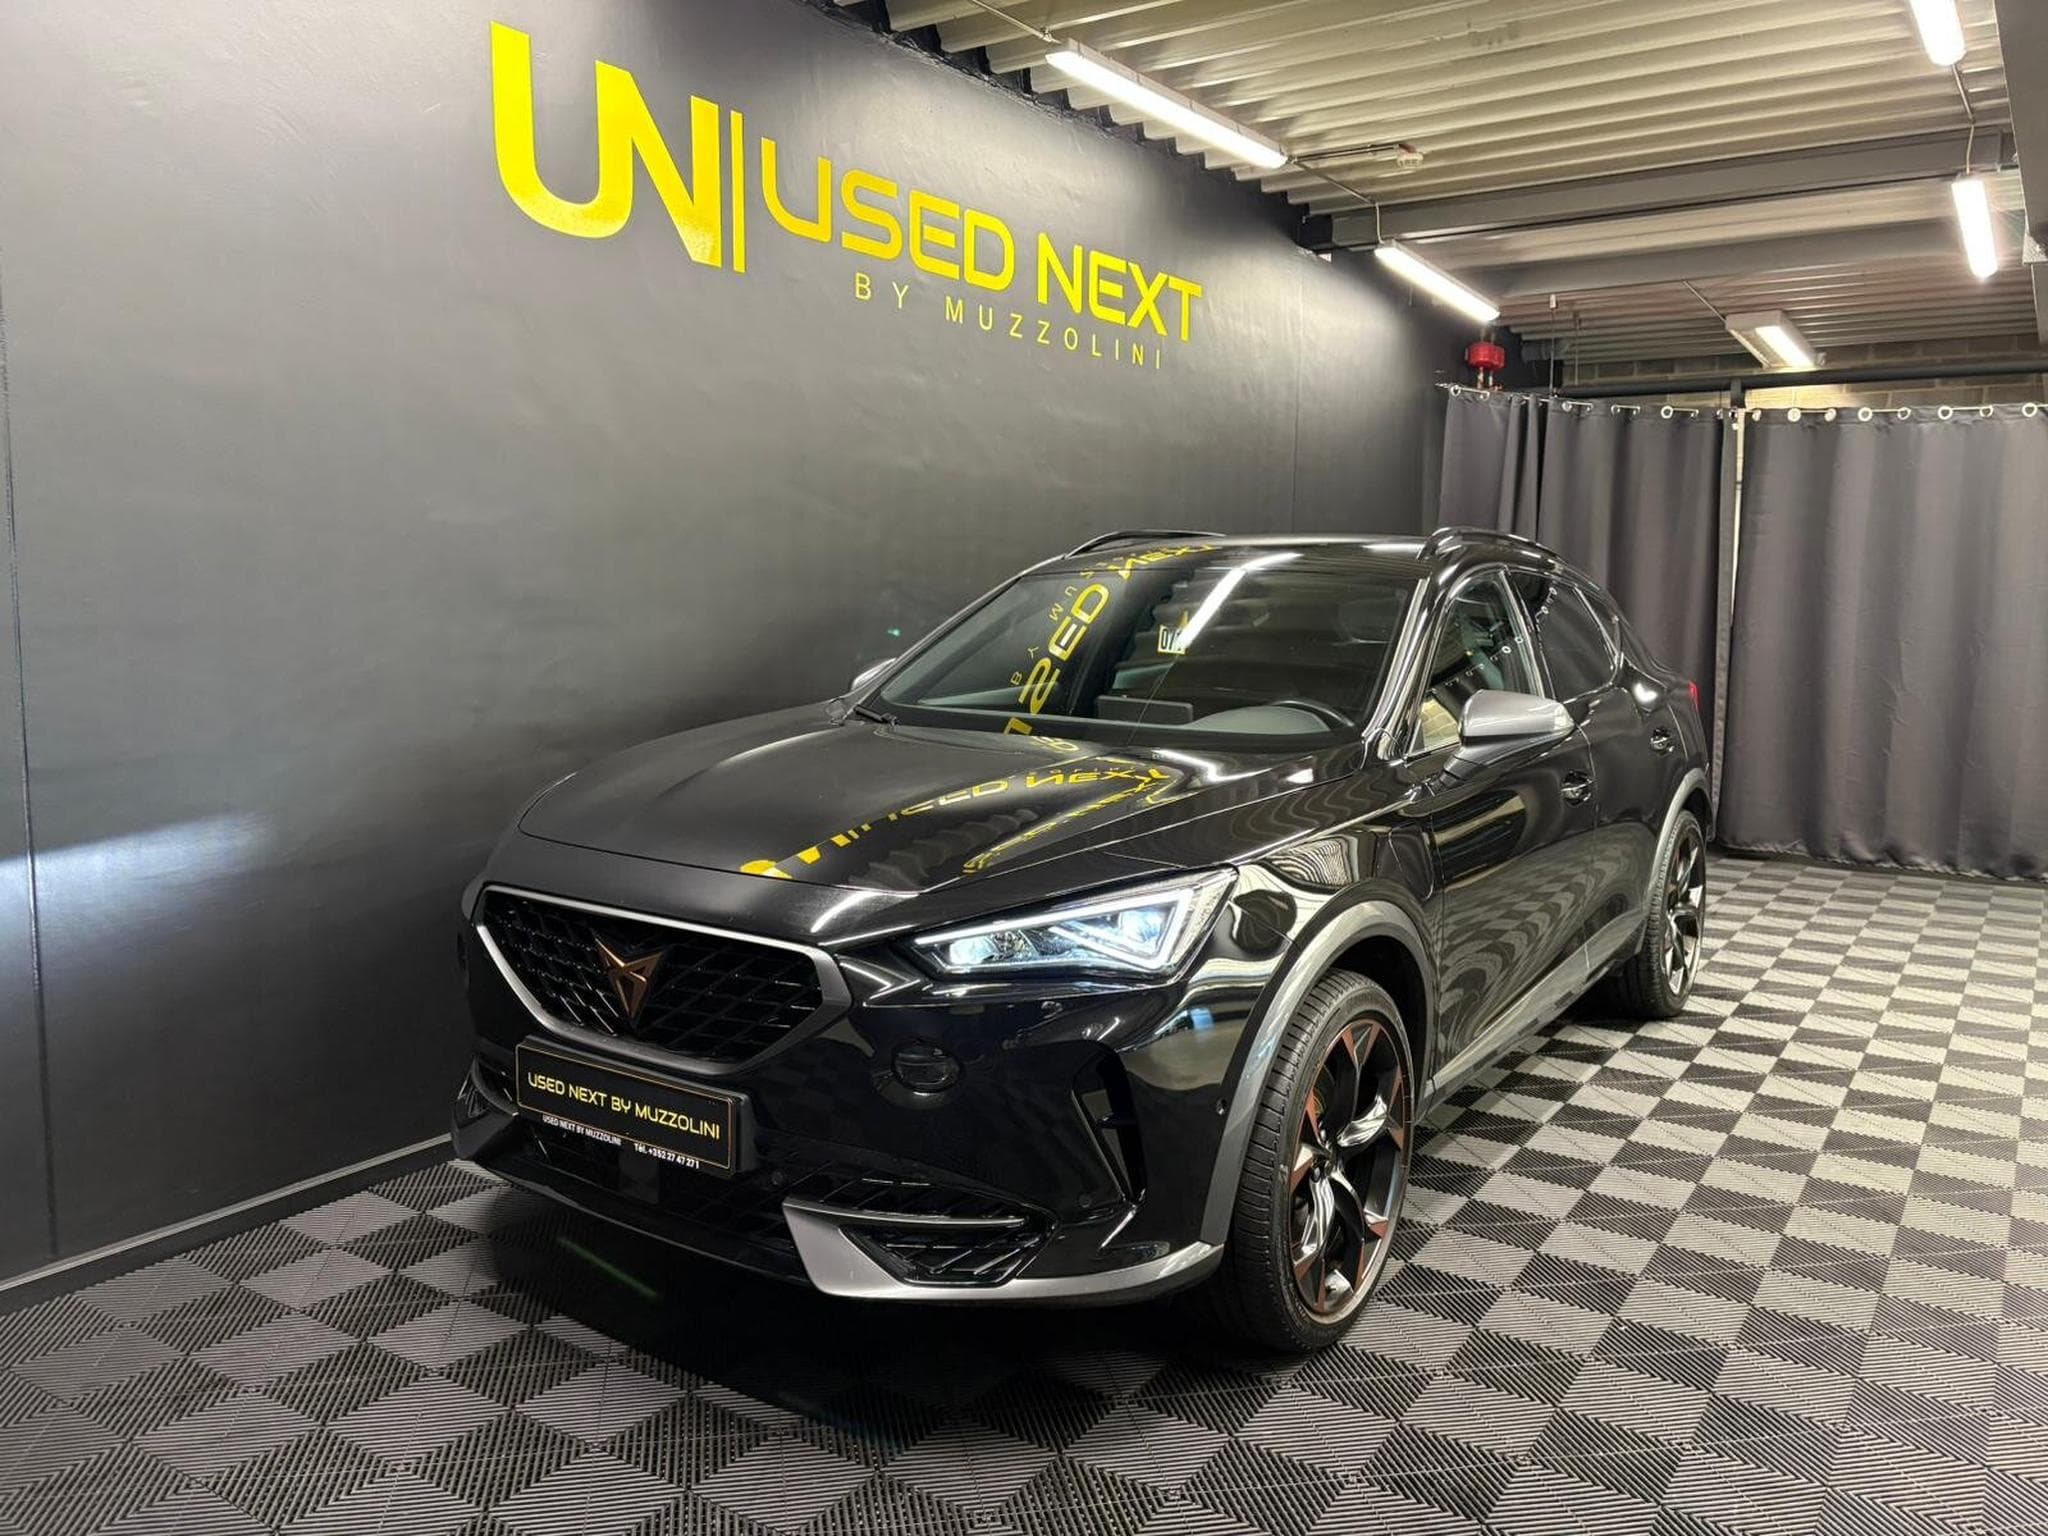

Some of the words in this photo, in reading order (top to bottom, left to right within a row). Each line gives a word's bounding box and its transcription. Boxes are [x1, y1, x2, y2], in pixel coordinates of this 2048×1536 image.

[760, 137, 1015, 291] USED
[1037, 232, 1203, 342] NEXT
[855, 272, 909, 310] BY
[945, 295, 1161, 370] MUZZOLINI
[527, 1072, 566, 1096] USED
[568, 1083, 608, 1108] NEXT
[610, 1096, 632, 1114] BY
[634, 1102, 720, 1140] MUZZOLINI
[542, 1114, 559, 1127] USED
[559, 1120, 576, 1133] NEXT
[576, 1125, 585, 1135] BY
[585, 1128, 622, 1146] MUZZOLINI
[648, 1147, 666, 1159] +352
[667, 1153, 676, 1162] 27
[676, 1155, 685, 1165] 47
